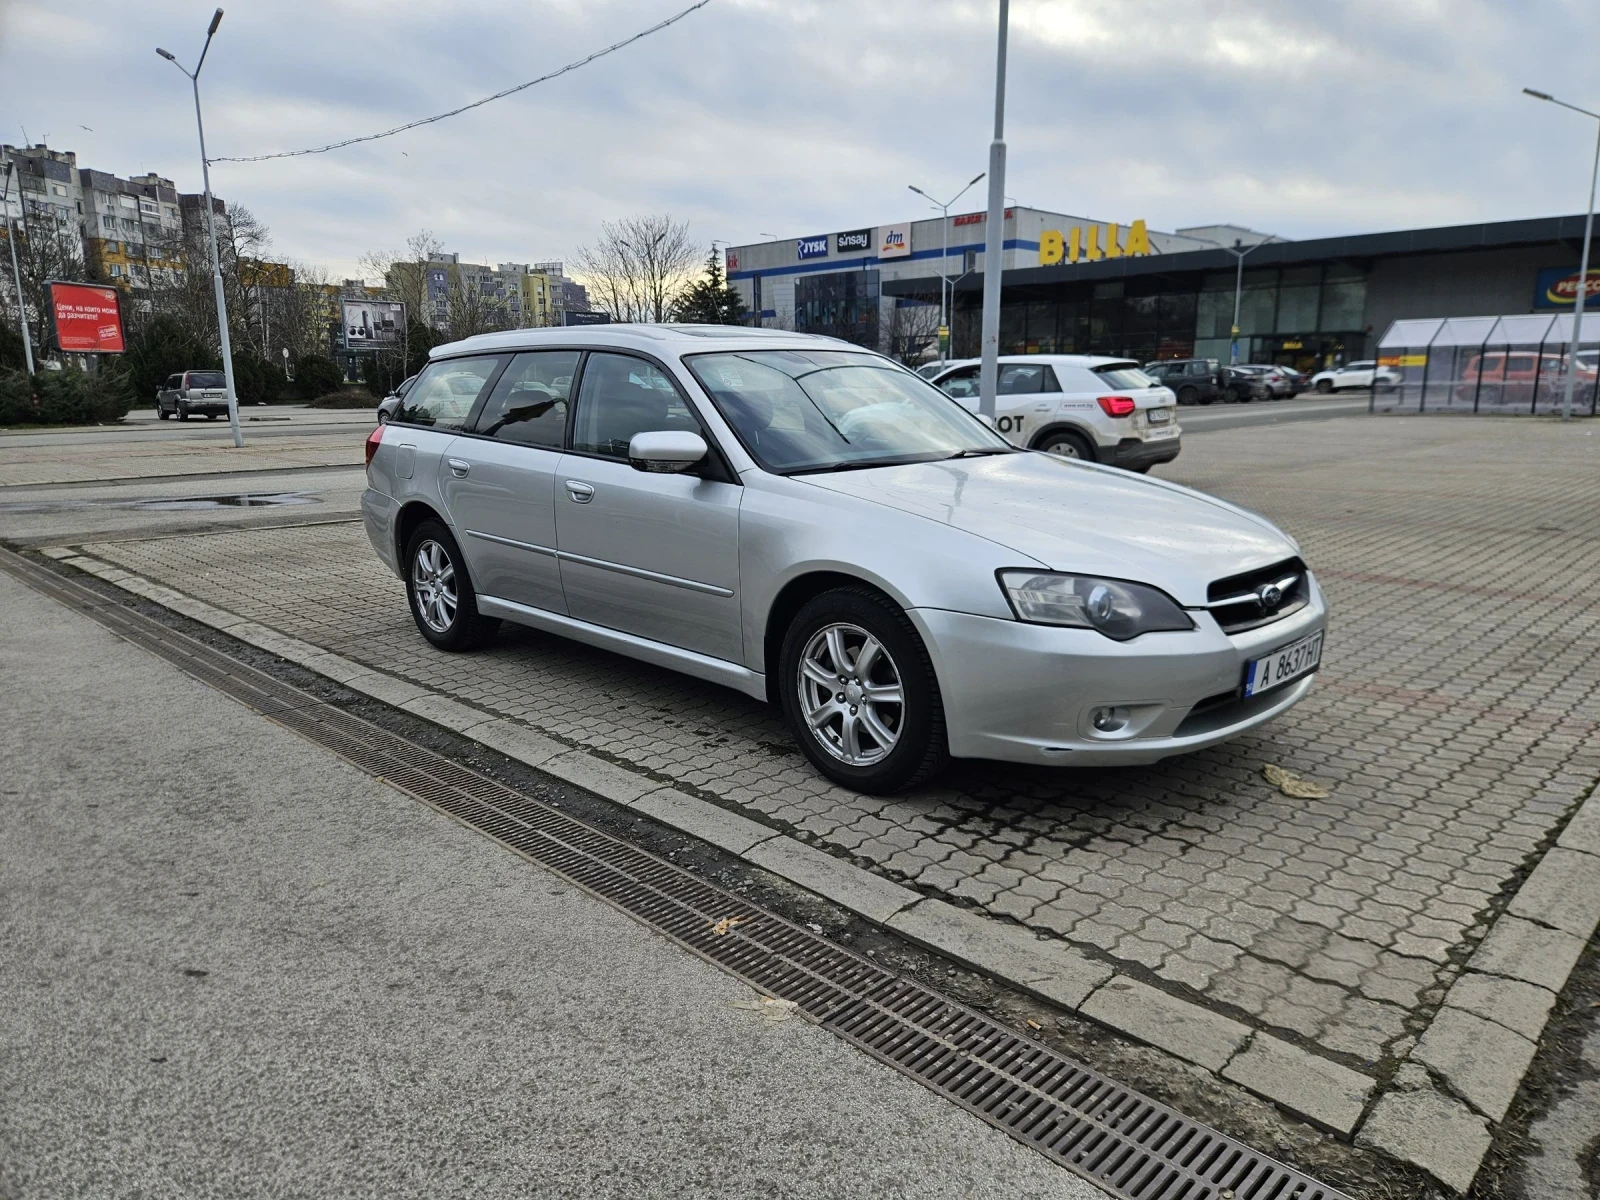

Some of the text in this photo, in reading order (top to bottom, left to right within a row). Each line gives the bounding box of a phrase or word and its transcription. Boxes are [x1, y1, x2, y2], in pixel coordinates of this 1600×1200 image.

[838, 233, 868, 248] sinsay
[886, 230, 904, 245] dm
[1039, 219, 1151, 266] BILLA
[803, 240, 827, 253] JYSK
[1556, 279, 1600, 294] PECO
[56, 303, 75, 313] Цени,
[994, 415, 1024, 433] OT
[1260, 637, 1320, 688] A 8637HT
